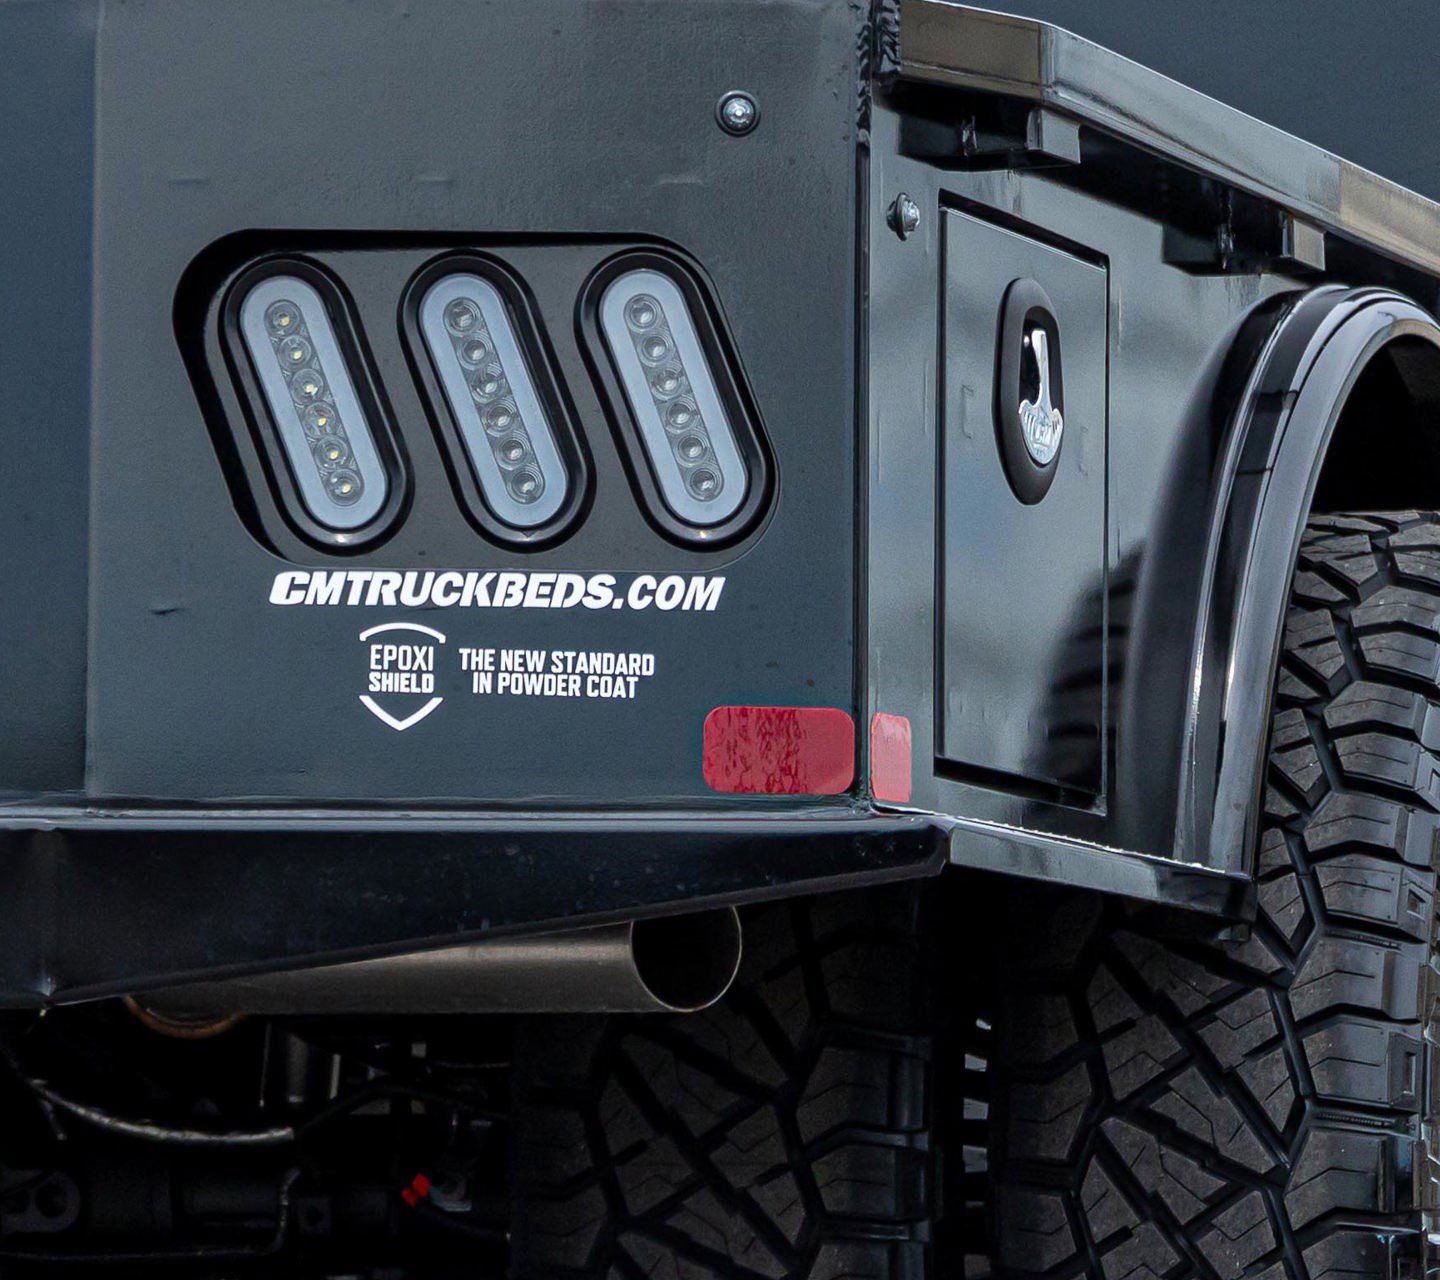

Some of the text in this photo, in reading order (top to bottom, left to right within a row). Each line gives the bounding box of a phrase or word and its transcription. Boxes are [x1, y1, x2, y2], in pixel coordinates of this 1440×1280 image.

[269, 570, 726, 611] CMTRUCKBEDS.COM
[370, 645, 433, 671] EPOXI
[459, 648, 655, 677] THE NEW STANDARD
[368, 672, 434, 694] SHIELD
[472, 672, 638, 699] IN POWDER COAT
